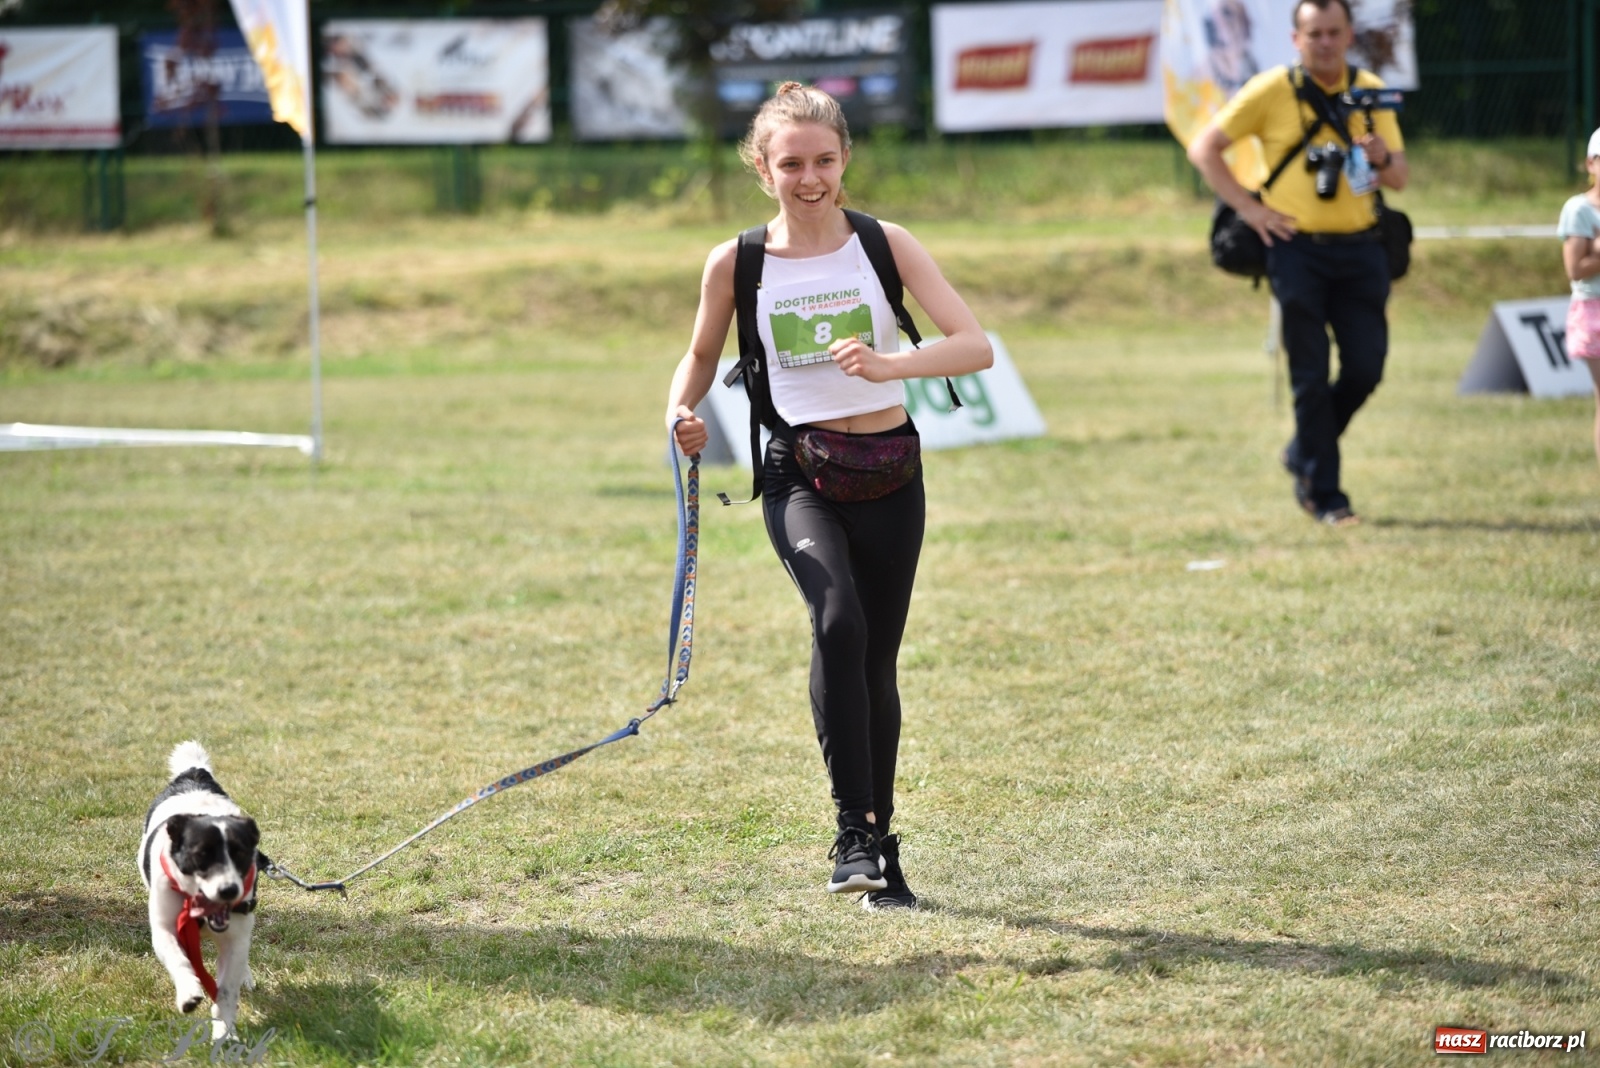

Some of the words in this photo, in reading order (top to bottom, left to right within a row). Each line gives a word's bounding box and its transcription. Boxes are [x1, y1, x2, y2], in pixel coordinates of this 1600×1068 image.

[774, 288, 860, 310] DOGTREKKING
[818, 297, 862, 310] RACIBORZU
[814, 321, 832, 344] 8
